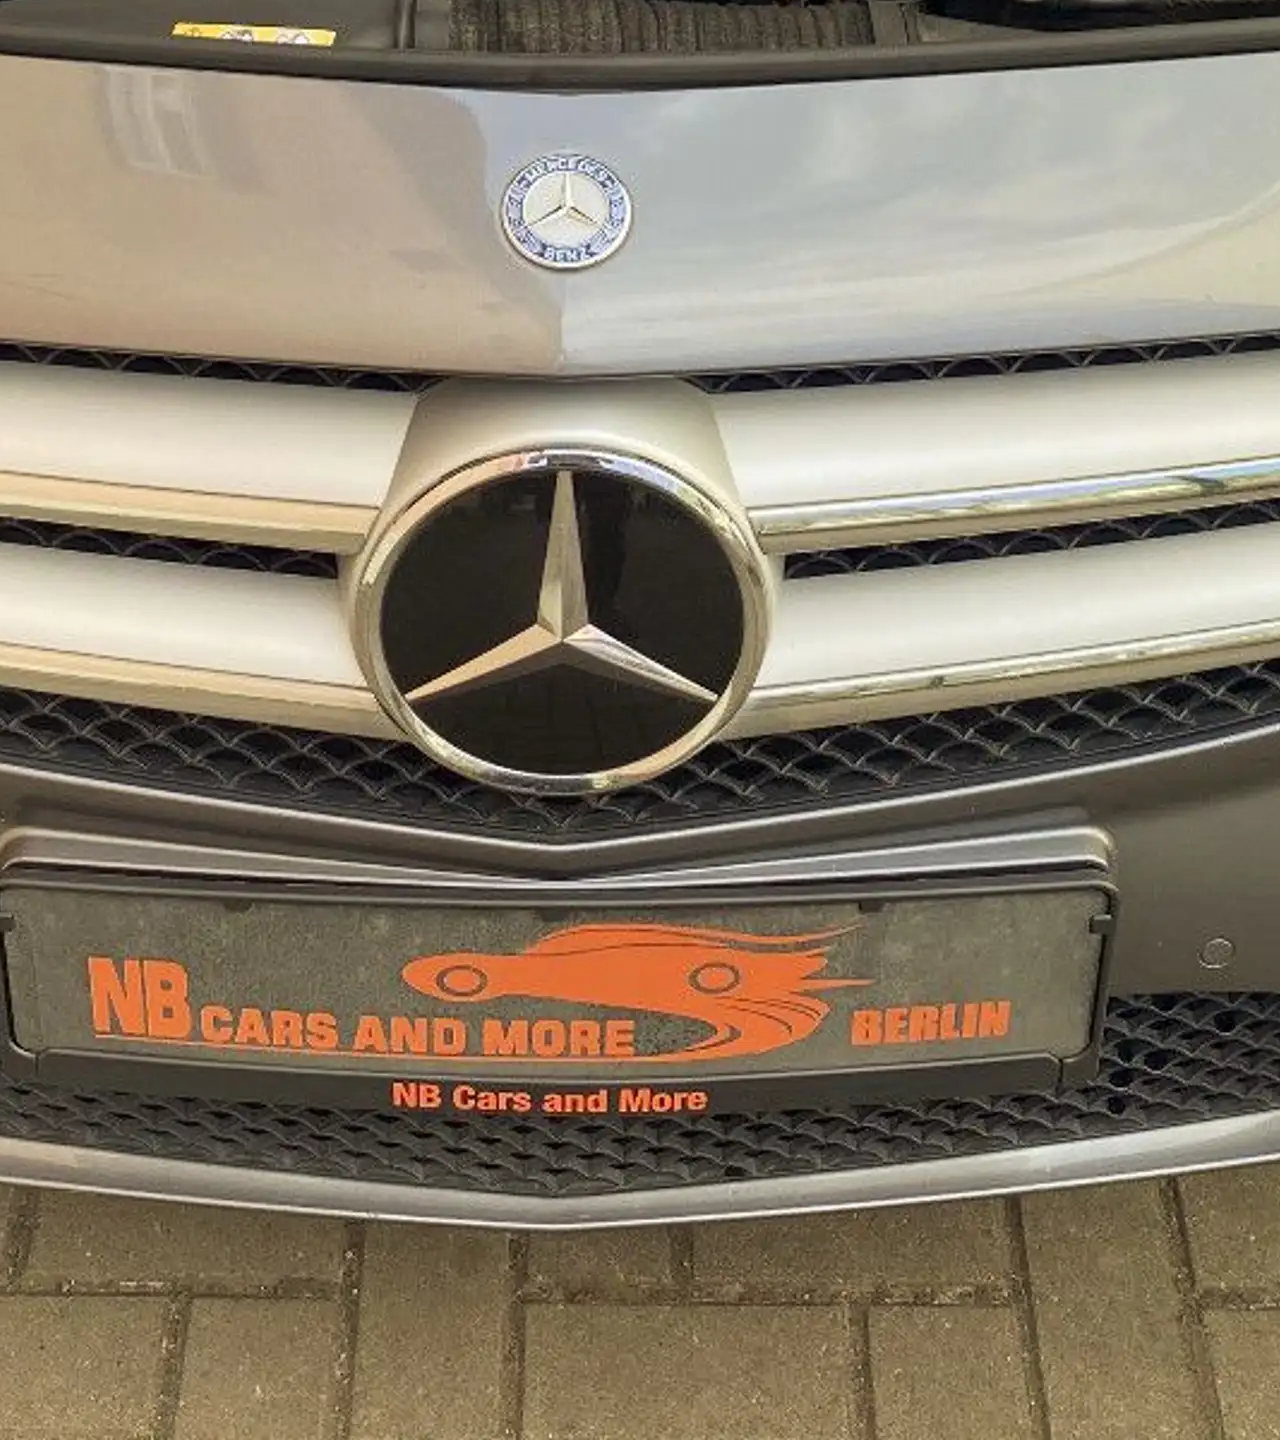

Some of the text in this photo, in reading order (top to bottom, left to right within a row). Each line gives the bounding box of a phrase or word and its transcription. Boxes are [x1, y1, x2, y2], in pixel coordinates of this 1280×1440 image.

[88, 956, 1011, 1057] NB CARS AND MORE BERLIN
[391, 1082, 708, 1113] NB Cars and More
